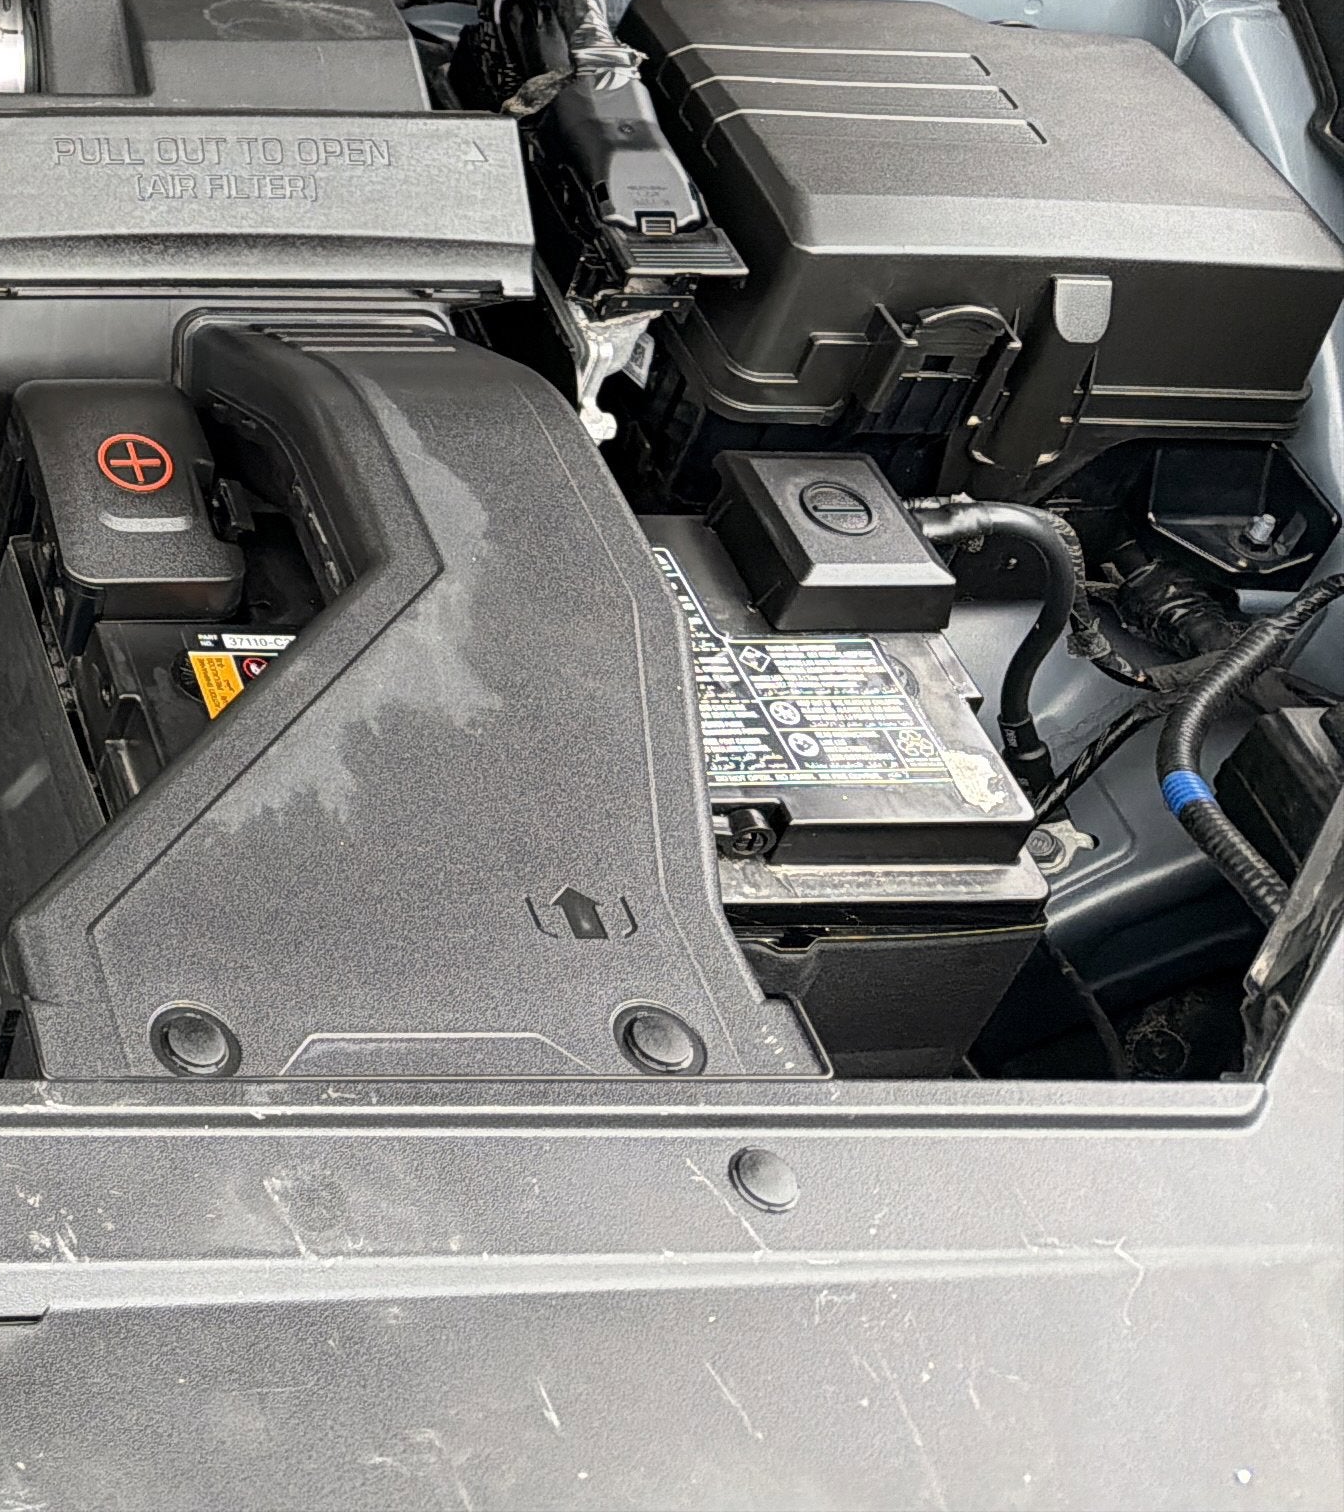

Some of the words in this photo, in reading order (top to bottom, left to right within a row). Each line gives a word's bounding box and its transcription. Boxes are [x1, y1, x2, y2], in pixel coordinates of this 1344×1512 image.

[55, 137, 145, 165] PULL
[158, 137, 226, 165] OUT
[237, 137, 284, 165] TO
[298, 138, 391, 167] OPEN
